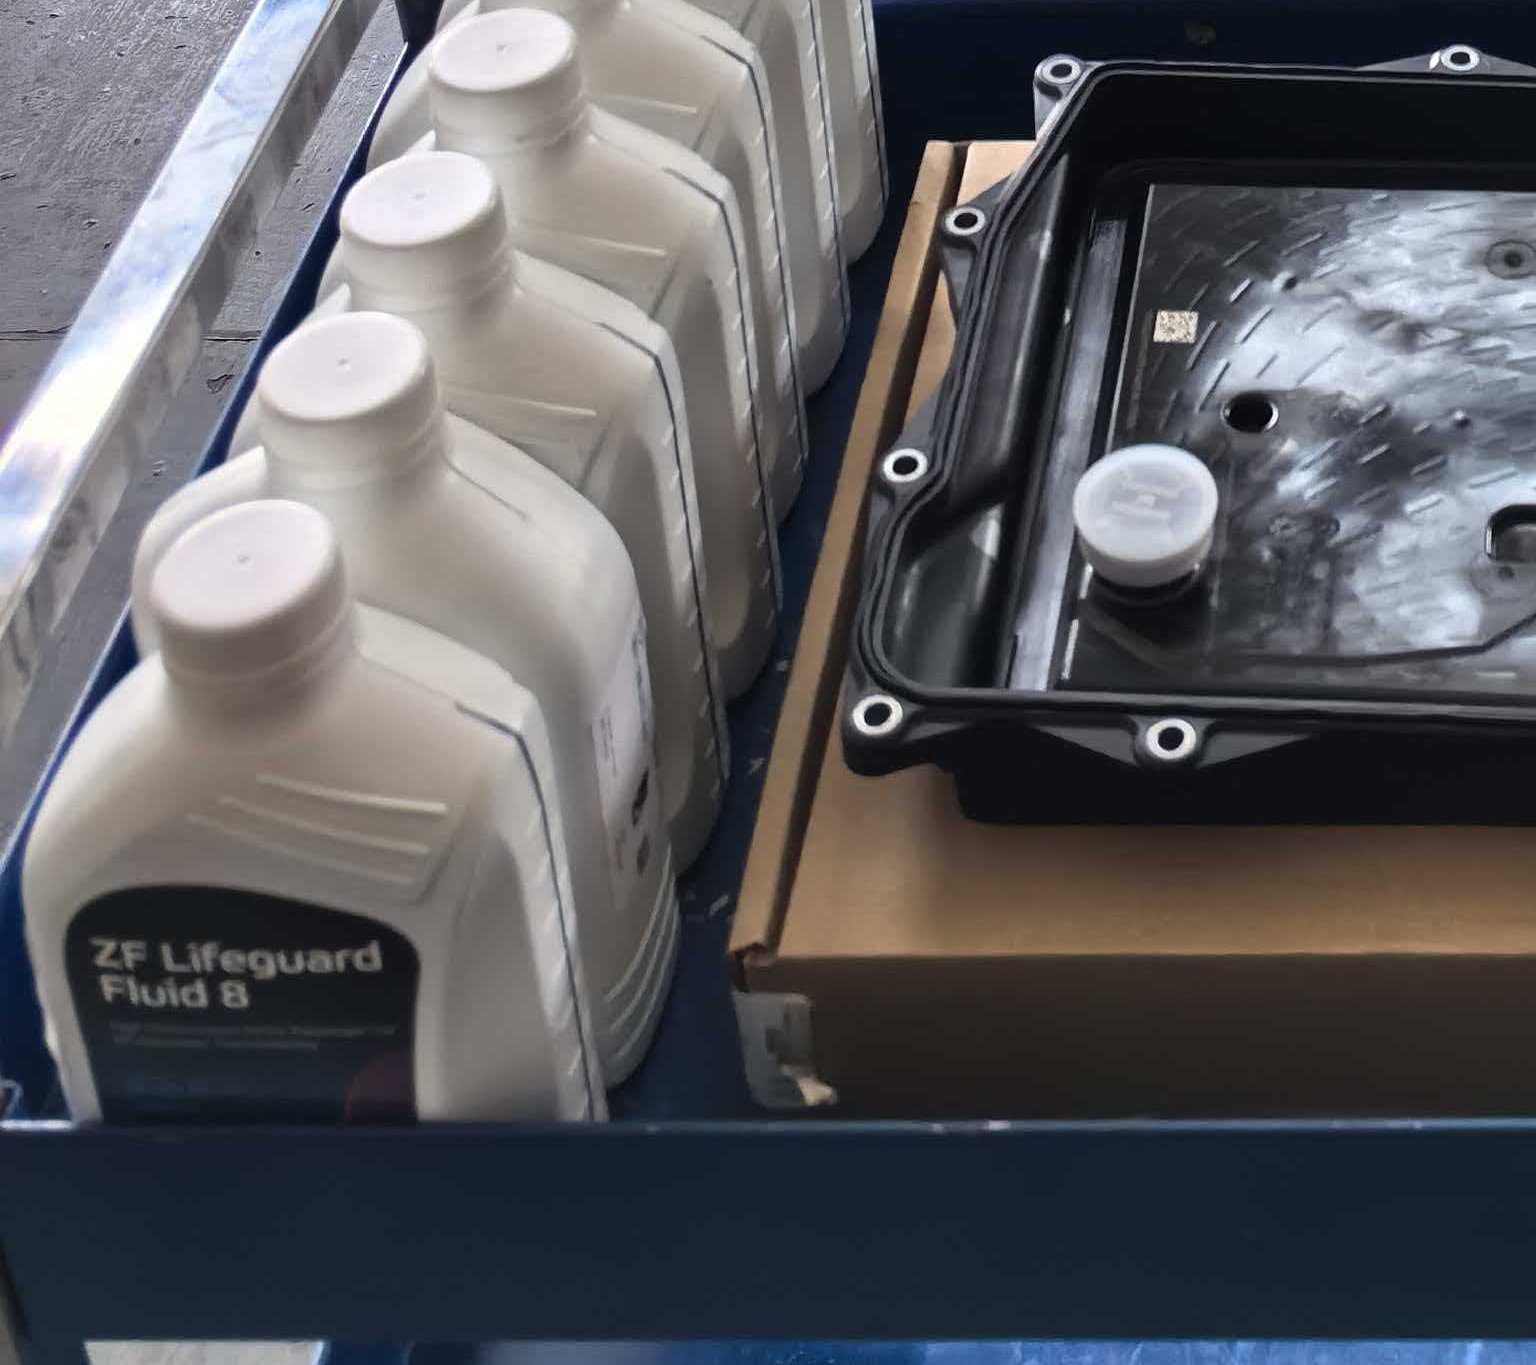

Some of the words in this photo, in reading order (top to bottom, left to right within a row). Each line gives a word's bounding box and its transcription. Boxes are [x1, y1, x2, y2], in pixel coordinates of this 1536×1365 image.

[90, 937, 147, 969] ZF
[159, 939, 383, 980] Lifeguard
[100, 973, 208, 1008] Fluid
[220, 978, 249, 1008] 8
